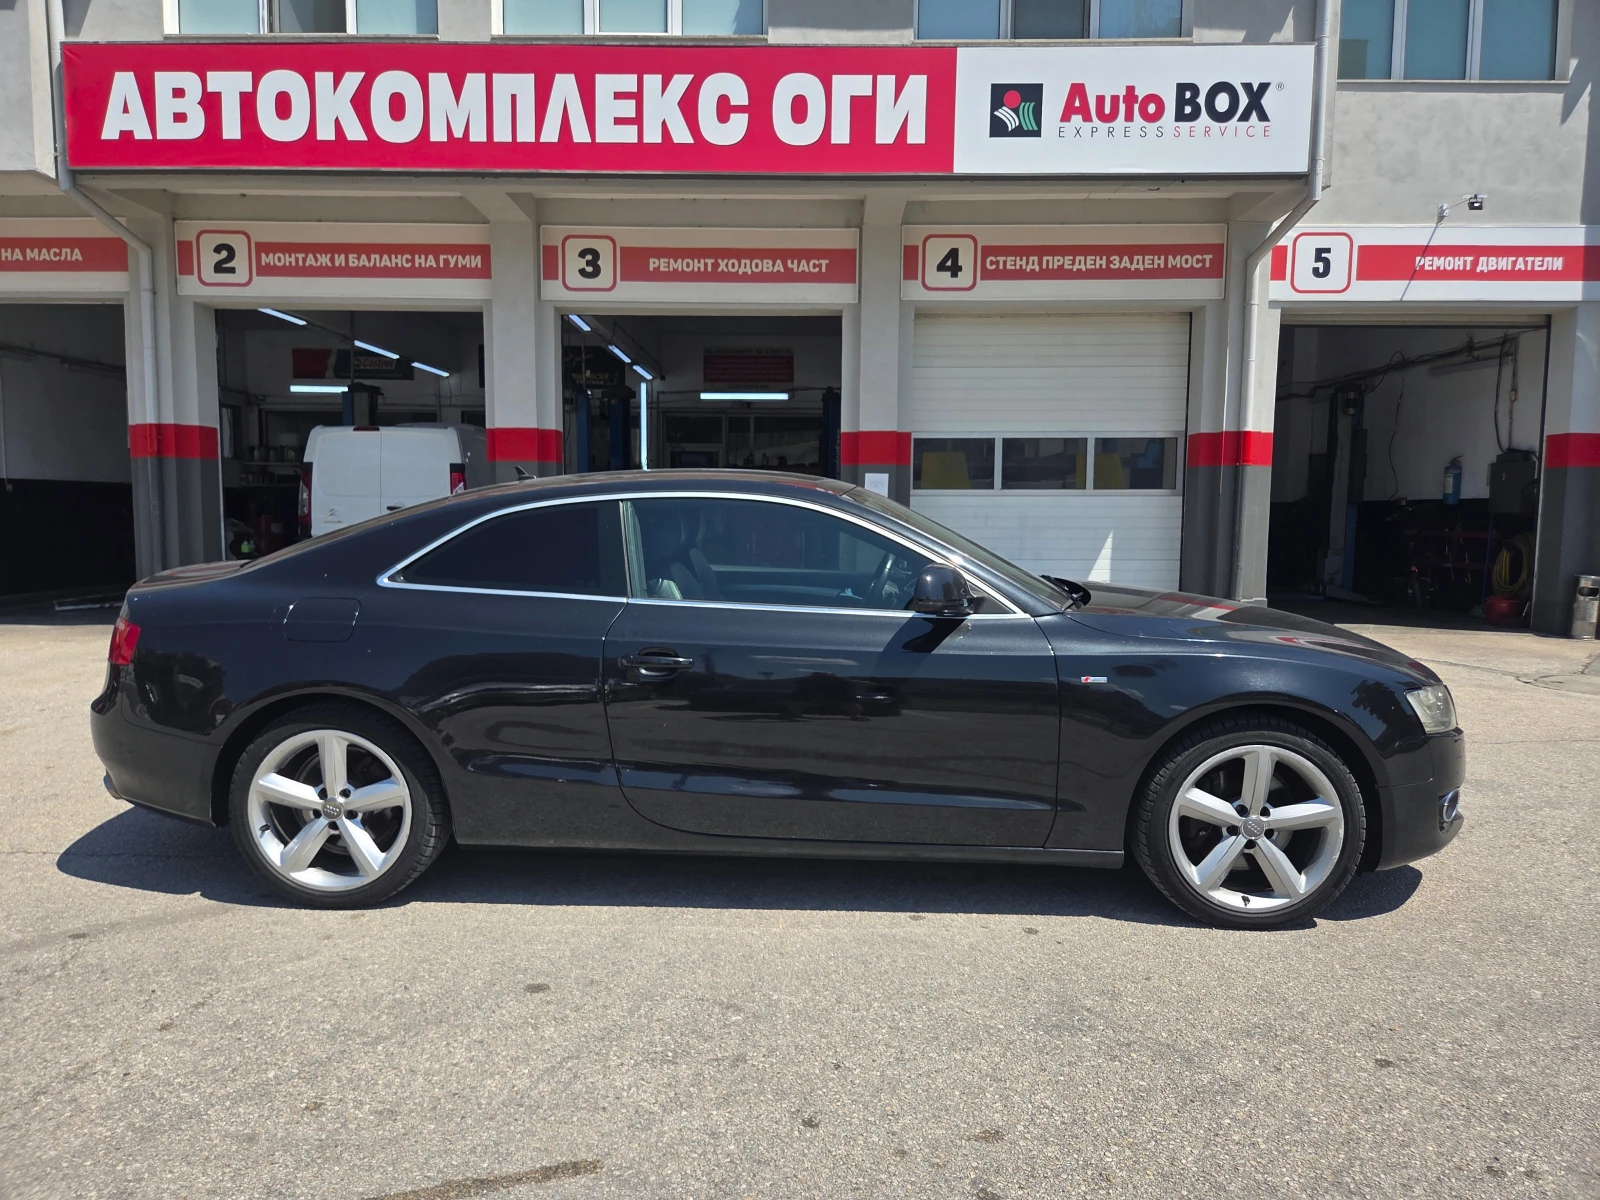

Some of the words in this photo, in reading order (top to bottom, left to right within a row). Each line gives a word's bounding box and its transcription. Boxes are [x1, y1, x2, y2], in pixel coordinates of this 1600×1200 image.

[101, 70, 749, 145] АВТОКОМПЛЕКС
[773, 73, 928, 147] ОГИ
[1059, 82, 1166, 123] Auto
[1174, 81, 1272, 123] BOX
[1, 247, 23, 261] НА
[26, 247, 83, 262] МАСЛА
[212, 243, 237, 274] 2
[261, 252, 332, 267] МОНТАЖ
[335, 253, 346, 267] И
[350, 253, 412, 268] БАЛАНС
[415, 254, 437, 268] НА
[439, 255, 482, 268] ГУМИ
[577, 248, 601, 279] 3
[649, 258, 714, 272] РЕМОНТ
[717, 258, 783, 275] ХОДОВА
[787, 259, 829, 273] ЧАСТ
[936, 247, 963, 278] 4
[985, 255, 1039, 272] СТЕНД
[1042, 255, 1104, 272] ПРЕДЕН
[1109, 255, 1164, 271] ЗАДЕН
[1167, 254, 1213, 269] МОСТ
[1311, 247, 1332, 279] 5
[1415, 256, 1473, 271] РЕМОНТ
[1476, 256, 1564, 272] ДВИГАТЕЛИ
[362, 358, 394, 368] Castrol
